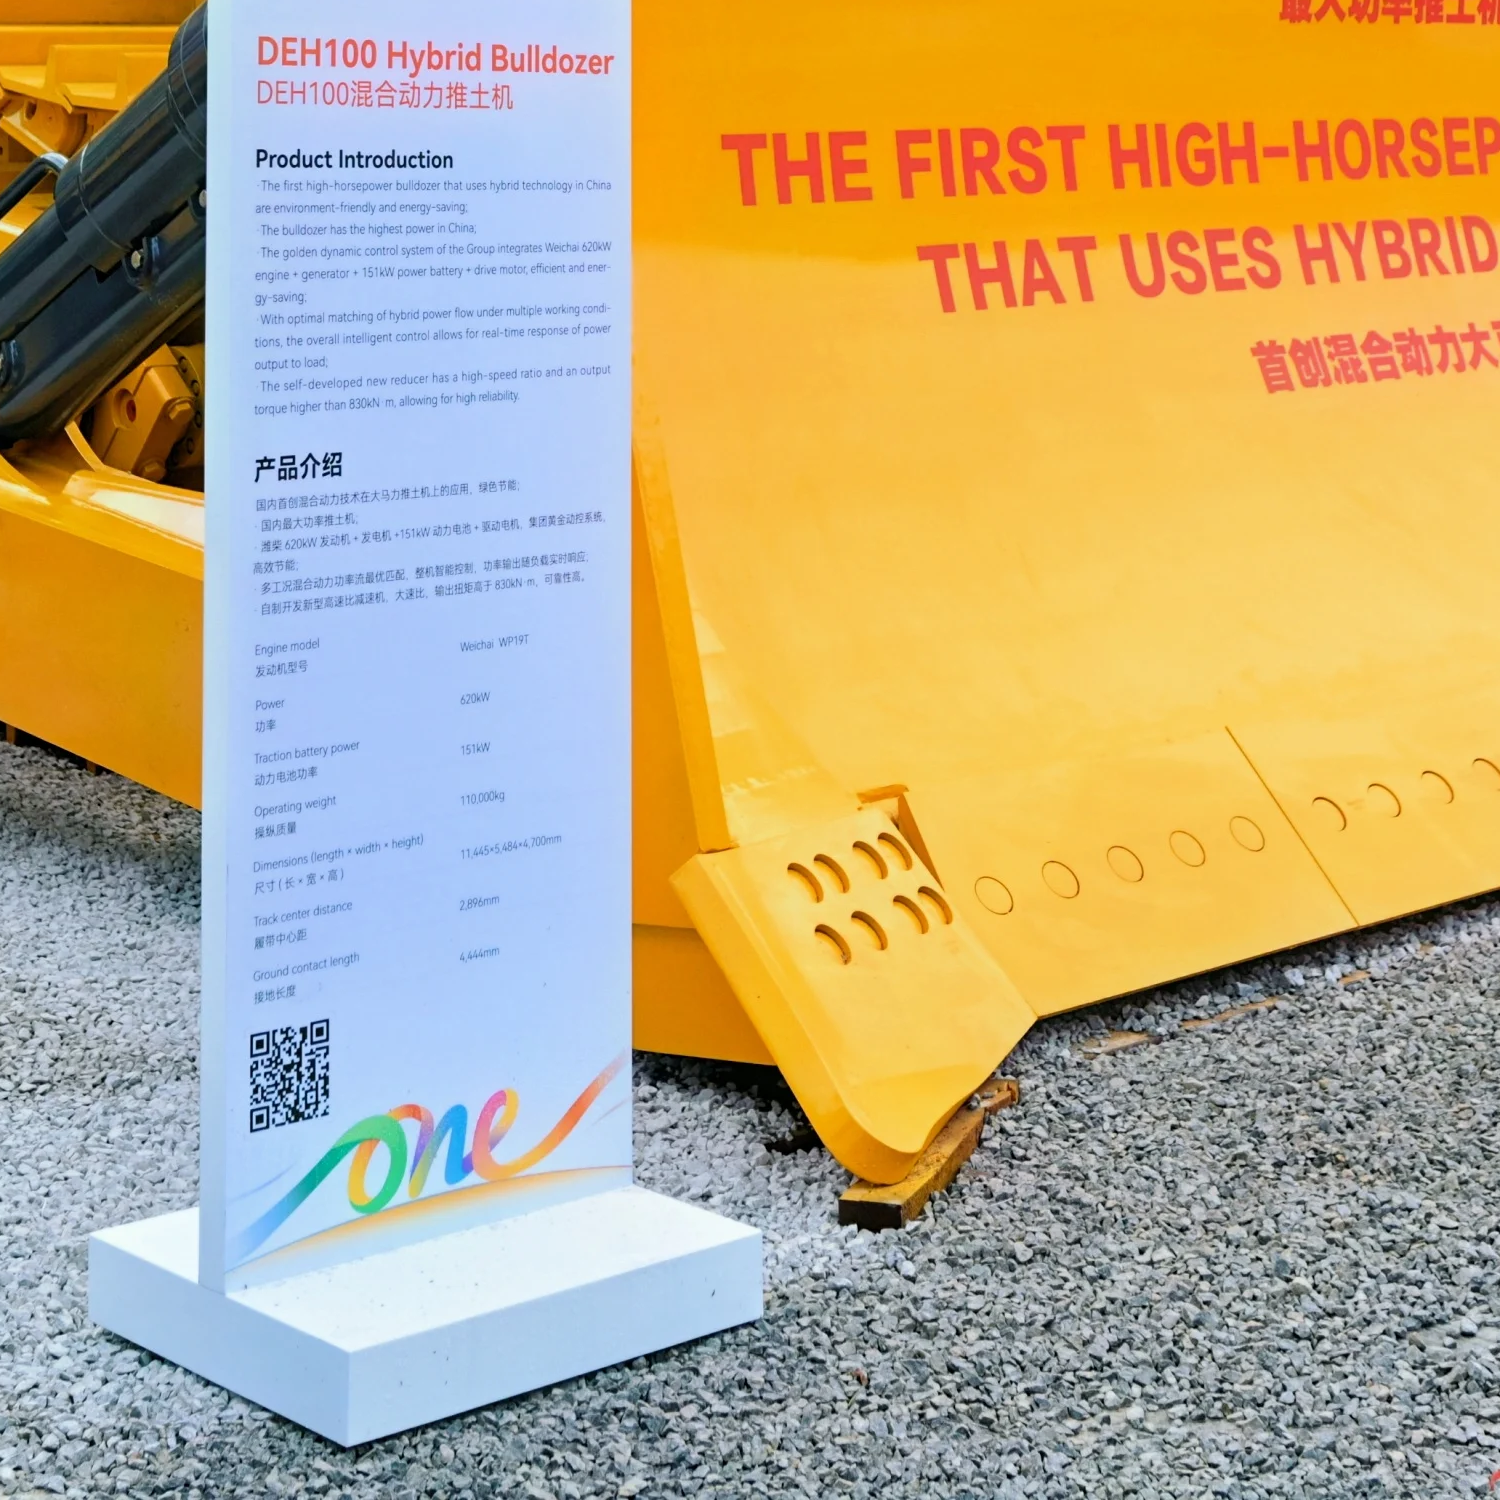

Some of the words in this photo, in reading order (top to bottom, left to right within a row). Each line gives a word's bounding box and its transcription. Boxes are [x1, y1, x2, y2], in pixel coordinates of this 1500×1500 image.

[258, 36, 376, 68] DEH100
[387, 40, 481, 77] Hybrid
[491, 43, 614, 74] Bulldozer
[257, 79, 513, 110] DEH100混合动力推土机
[256, 148, 332, 168] Product
[339, 149, 453, 168] Introduction
[720, 129, 874, 206] THE
[894, 124, 1086, 200] FIRST
[260, 179, 280, 191] The
[283, 179, 302, 191] first
[306, 179, 392, 194] high-horsepower
[395, 179, 440, 190] bulldozer
[443, 180, 463, 190] that
[465, 182, 487, 190] uses
[489, 180, 519, 193] hybrid
[522, 179, 572, 193] technology
[575, 180, 583, 190] in
[586, 179, 611, 190] China
[255, 204, 271, 213] are
[273, 201, 376, 215] environment-friendly
[378, 201, 396, 212] and
[260, 224, 279, 235] The
[282, 224, 327, 235] bulldozer
[330, 224, 347, 234] has
[349, 223, 365, 234] the
[368, 223, 403, 237] highest
[405, 225, 434, 235] power
[437, 222, 445, 232] in
[260, 246, 279, 258] The
[282, 246, 317, 261] golden
[320, 246, 361, 260] dynamic
[364, 244, 398, 256] control
[401, 245, 433, 258] system
[436, 243, 446, 254] of
[448, 243, 464, 254] the
[466, 243, 495, 255] Group
[497, 243, 542, 256] integrates
[544, 242, 579, 252] Weichai
[581, 241, 611, 252] 620kW
[254, 269, 289, 283] engine
[301, 269, 349, 282] generator
[362, 266, 395, 277] 151kW
[397, 268, 427, 279] power
[429, 265, 463, 278] battery
[473, 264, 496, 275] drive
[499, 265, 528, 275] motor,
[530, 262, 565, 274] efficient
[568, 262, 584, 272] and
[915, 234, 1100, 314] THAT
[1117, 224, 1284, 299] USES
[1295, 213, 1499, 287] HYBRID
[260, 313, 284, 324] With
[287, 312, 324, 326] optimal
[328, 310, 373, 324] matching
[376, 309, 387, 321] of
[389, 308, 419, 323] hybrid
[422, 310, 452, 321] power
[454, 306, 474, 318] flow
[476, 306, 503, 317] under
[506, 305, 542, 318] multiple
[544, 303, 580, 317] working
[254, 359, 288, 372] output
[291, 358, 301, 368] to
[254, 404, 287, 417] torque
[290, 401, 321, 415] higher
[324, 399, 346, 411] than
[399, 395, 437, 407] allowing
[440, 392, 453, 404] for
[456, 391, 476, 405] high
[254, 452, 342, 482] 产品介绍
[254, 644, 287, 657] Engine
[290, 637, 319, 651] model
[459, 640, 493, 652] Weichai
[498, 634, 529, 647] WP19T
[255, 659, 308, 677] 发动机型号
[255, 699, 284, 710] Power
[460, 691, 490, 705] 620kW
[255, 718, 275, 732] 功率
[254, 750, 291, 764] Traction
[294, 746, 328, 758] battery
[330, 741, 360, 756] power
[461, 741, 490, 755] 151kW
[254, 766, 317, 786] 动力电池功率
[254, 802, 302, 819] Operating
[304, 795, 336, 810] weight
[254, 821, 296, 839] 操纵质量
[253, 855, 308, 872] Dimensions
[354, 841, 380, 854] width
[459, 895, 499, 911] 2,896mm
[253, 913, 278, 926] Track
[280, 909, 310, 922] center
[313, 901, 352, 916] distance
[254, 928, 306, 949] 履带中心距
[459, 947, 499, 963] 4,444mm
[252, 964, 289, 981] Ground
[291, 959, 327, 974] contact
[329, 951, 359, 967] length
[254, 984, 295, 1004] 接地长度
